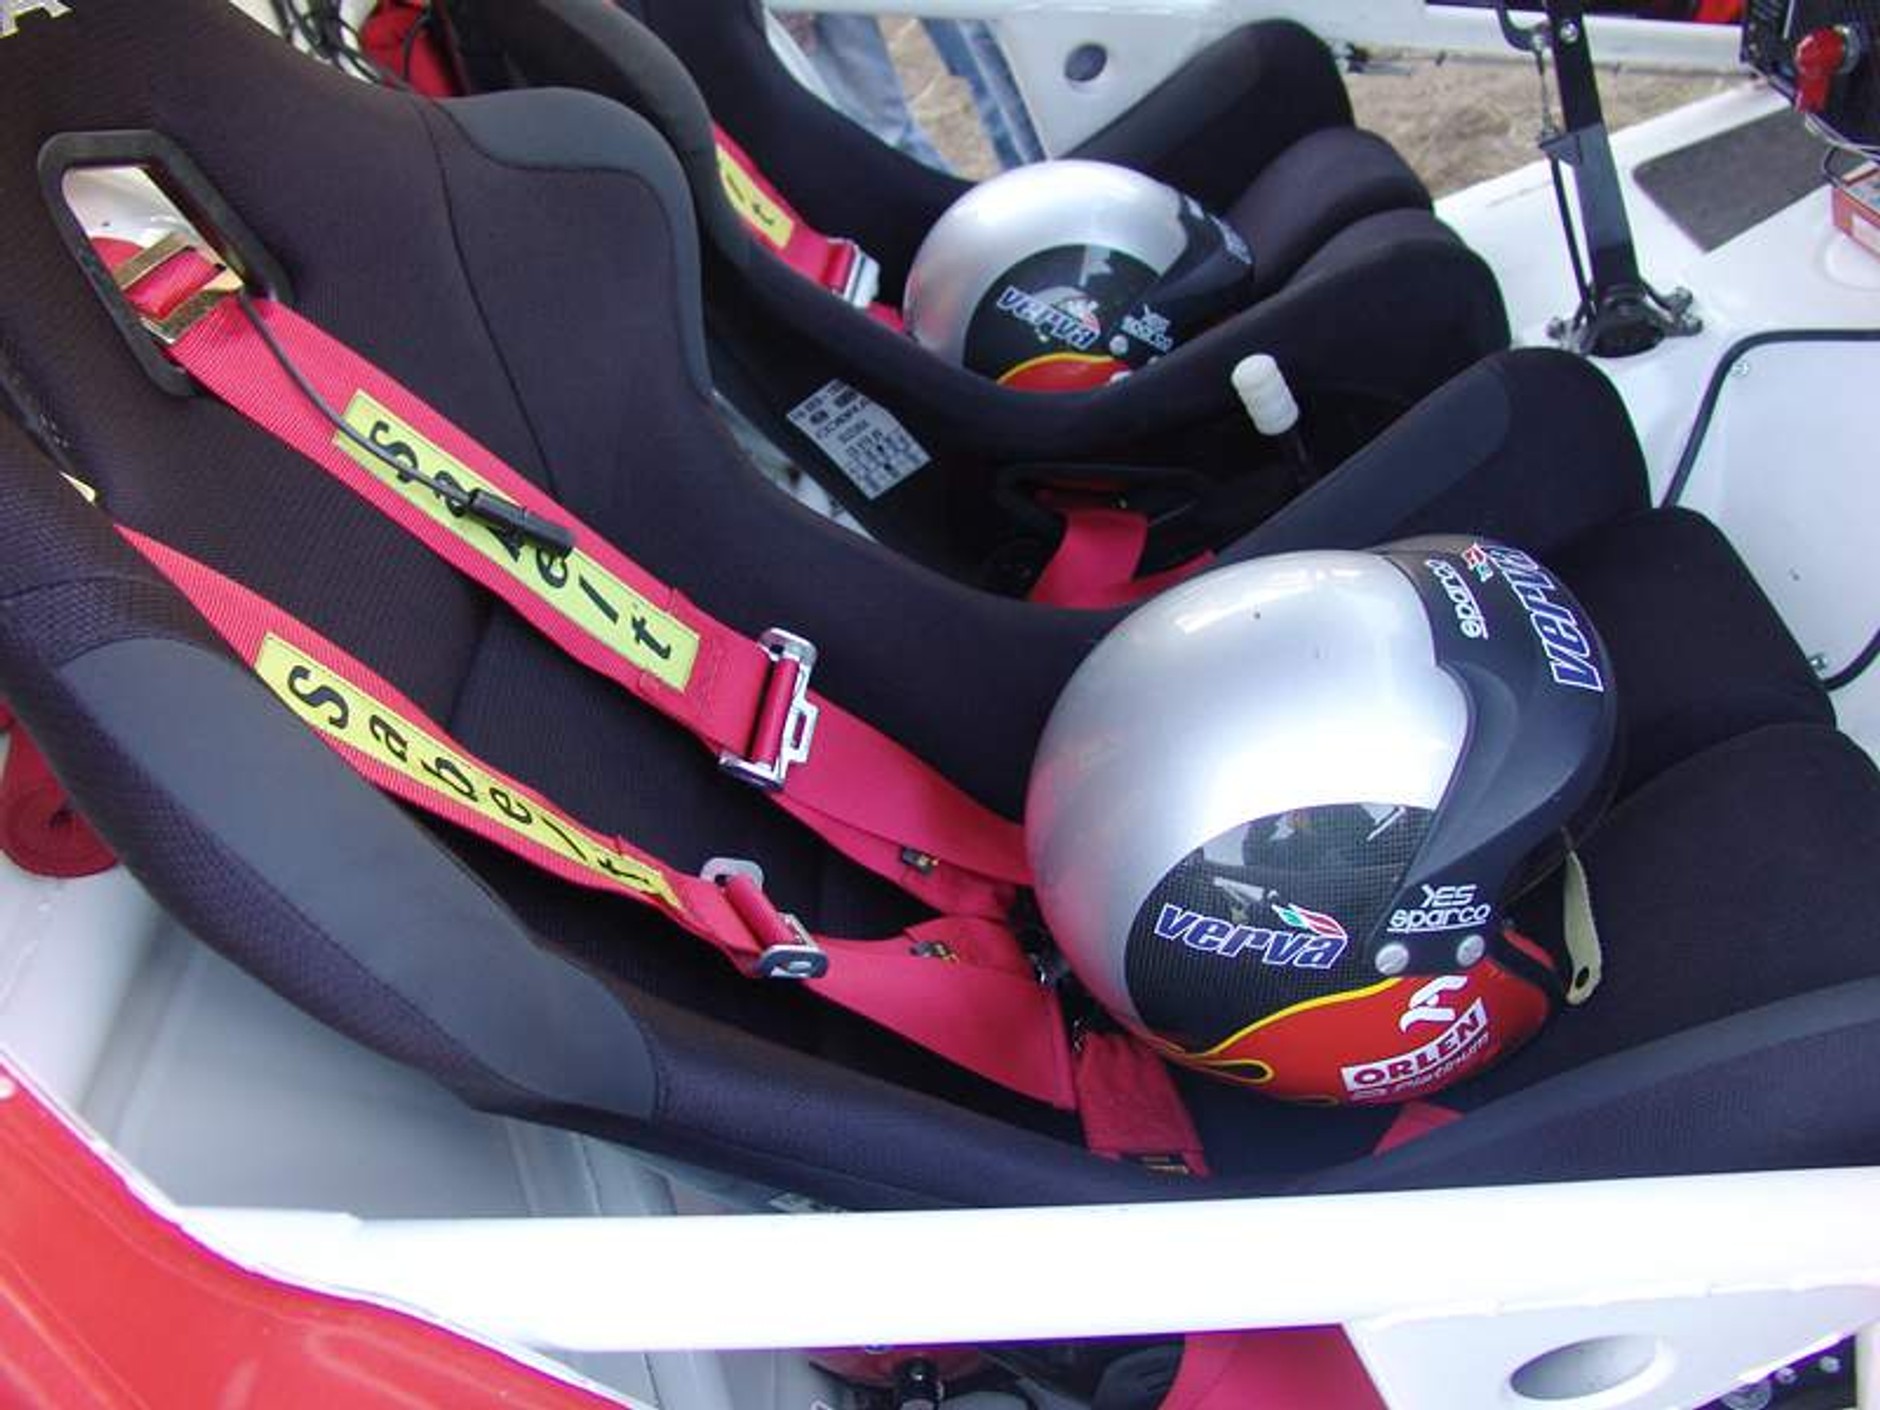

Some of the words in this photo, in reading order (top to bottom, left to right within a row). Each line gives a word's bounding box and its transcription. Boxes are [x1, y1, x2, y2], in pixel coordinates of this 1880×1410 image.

[287, 664, 650, 884] Sabelt
[1154, 902, 1348, 970] verva
[1386, 903, 1491, 933] sparco
[1353, 1009, 1480, 1086] ORLEN
